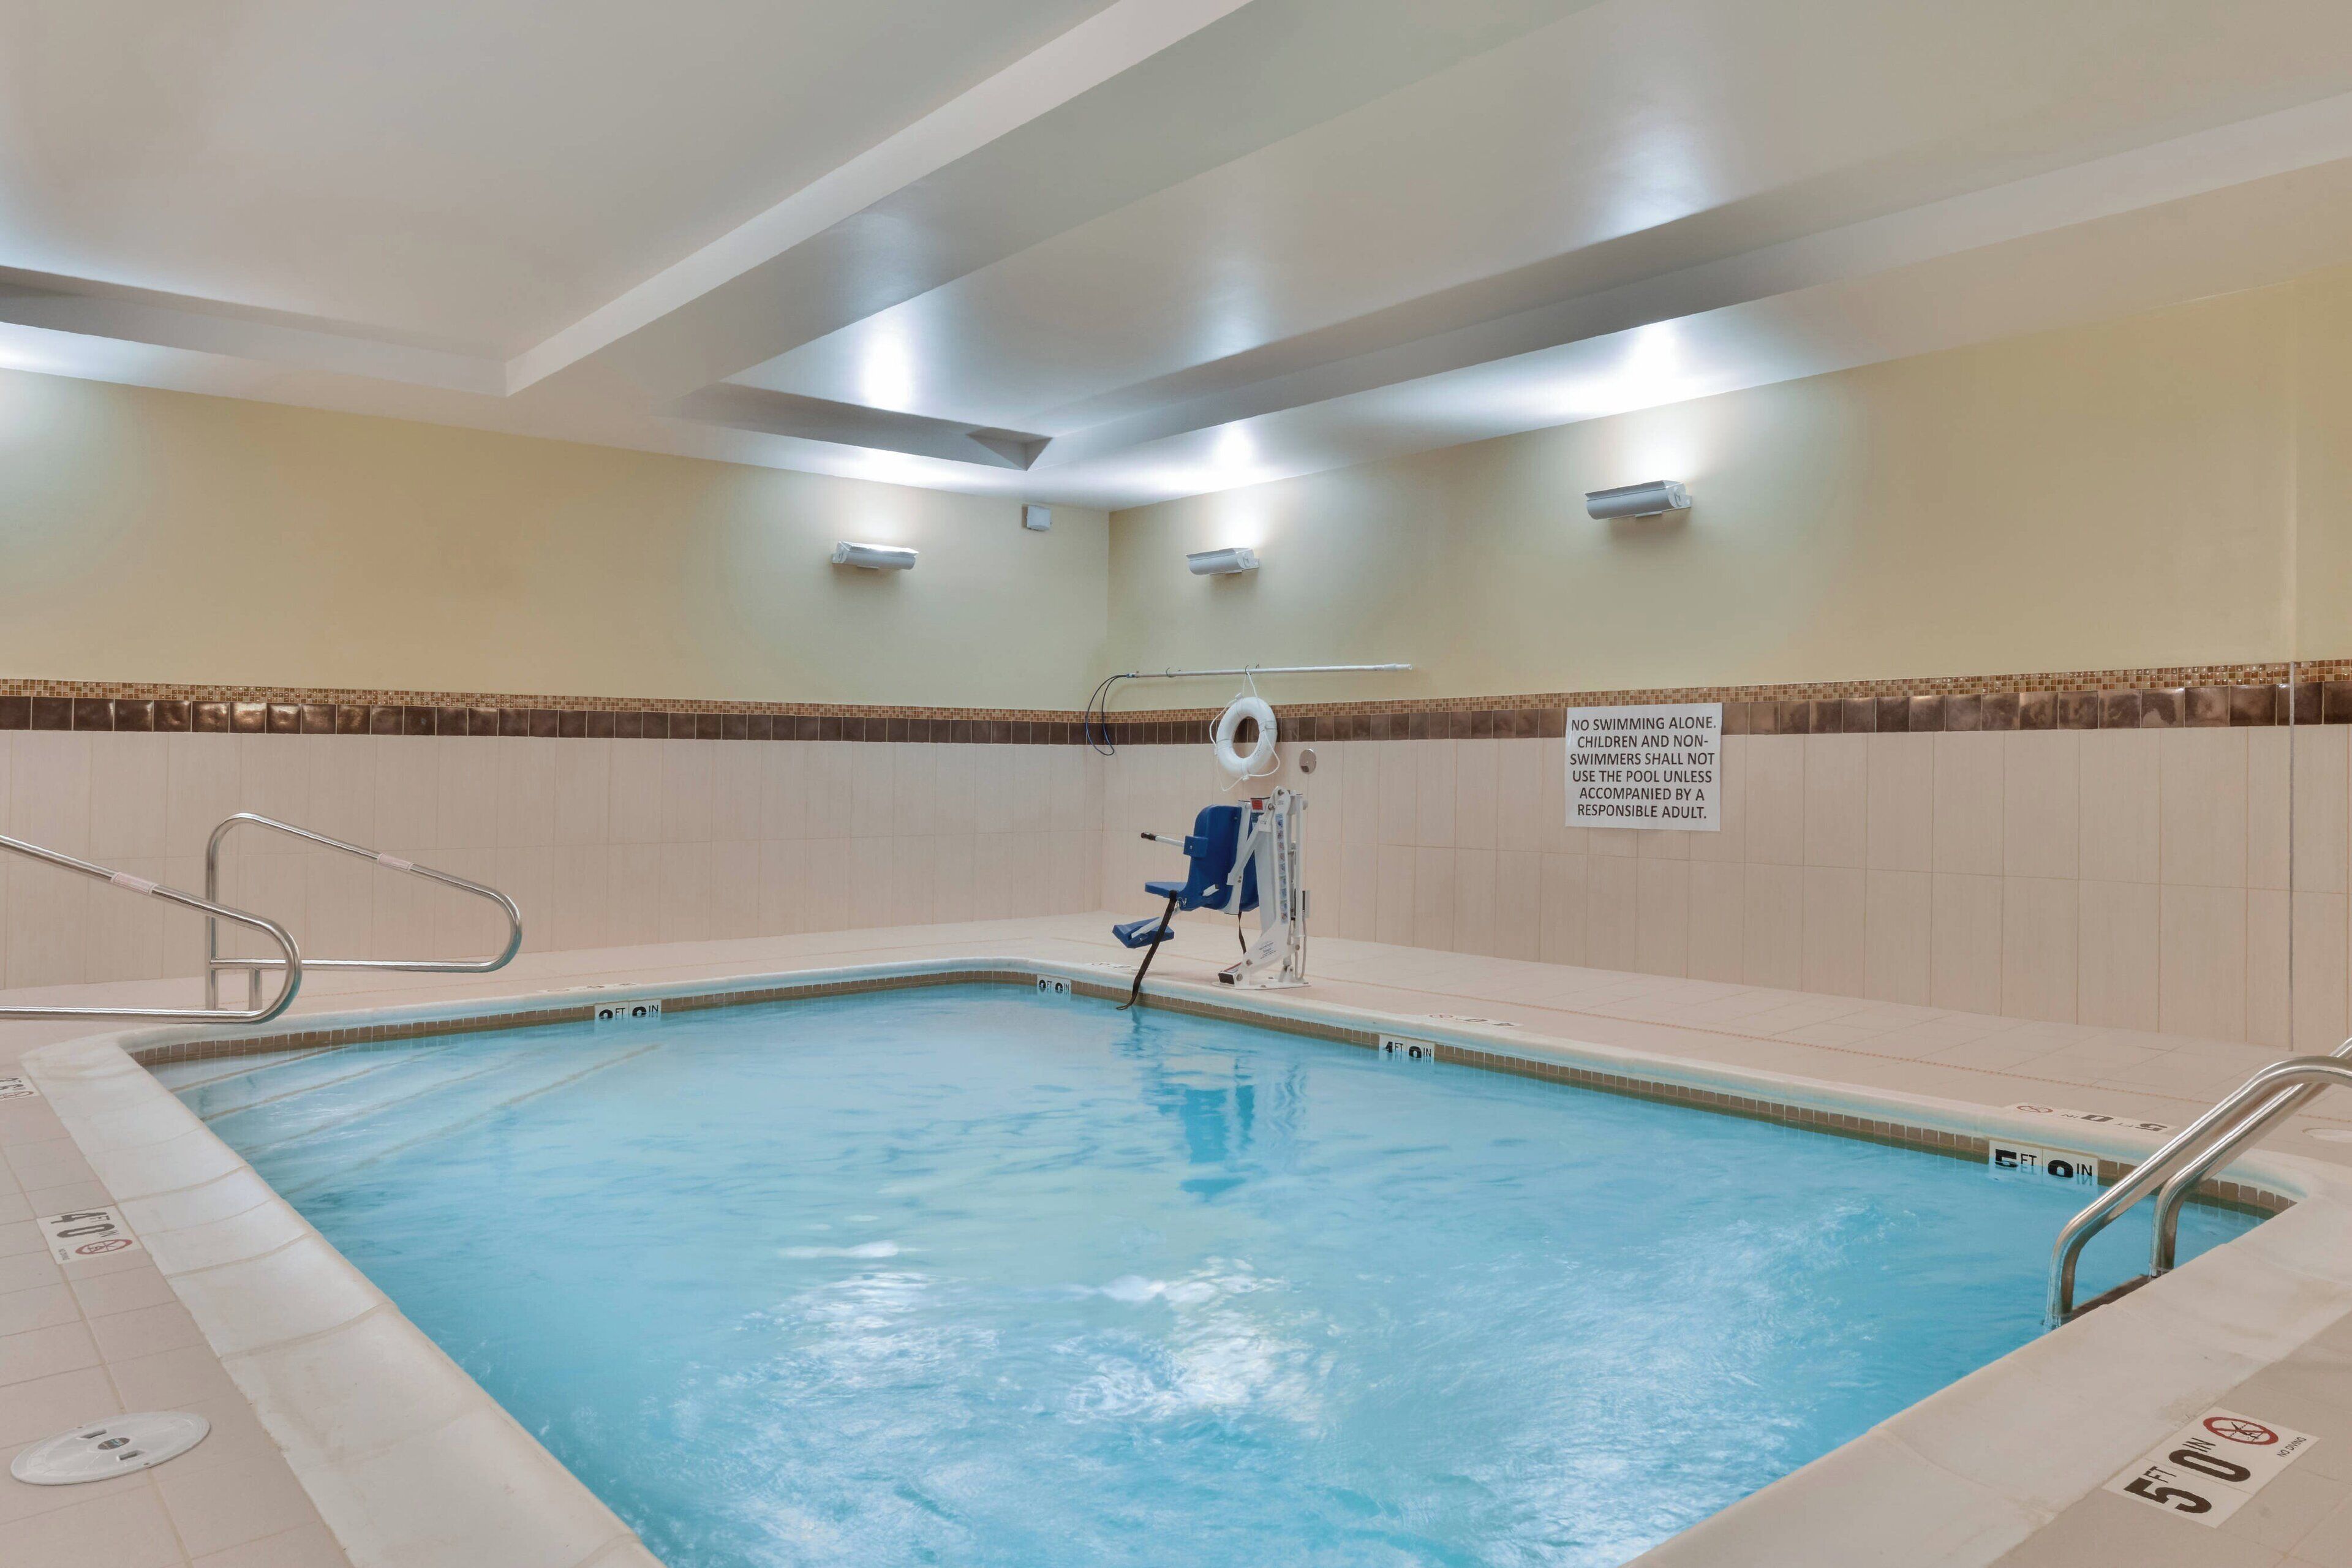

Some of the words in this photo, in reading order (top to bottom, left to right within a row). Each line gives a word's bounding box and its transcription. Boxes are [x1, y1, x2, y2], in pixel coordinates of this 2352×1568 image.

[1571, 719, 1589, 731] NO
[1593, 717, 1665, 731] SWIMMING
[1669, 716, 1716, 729] ALONE.
[1577, 736, 1637, 748] CHILDREN
[1641, 735, 1669, 747] AND
[1673, 734, 1708, 747] NON-
[1570, 753, 1641, 766] SWIMMERS
[1645, 753, 1683, 765] SHALL
[1687, 753, 1715, 765] NOT
[1572, 771, 1595, 782] USE
[1599, 771, 1622, 782] THE
[1626, 771, 1659, 783] POOL
[1664, 771, 1712, 783] UNLESS
[1579, 787, 1671, 800] ACCOMPANIED
[1675, 788, 1691, 801] BY
[1695, 789, 1705, 801] A
[1577, 804, 1657, 818] RESPONSIBLE
[1662, 806, 1707, 819] ADULT.
[649, 1005, 658, 1013] IN
[1384, 1041, 1393, 1053] 4
[1395, 1042, 1403, 1052] FT
[1423, 1047, 1431, 1057] IN
[2021, 1153, 2037, 1166] FT
[2048, 1159, 2073, 1178] 0
[2076, 1163, 2092, 1177] IN
[56, 1223, 115, 1238] 0
[2182, 1437, 2216, 1453] IN
[2285, 1437, 2307, 1450] DIVING
[2169, 1449, 2250, 1482] 0
[2143, 1466, 2177, 1483] FT
[2124, 1477, 2212, 1513] 5
